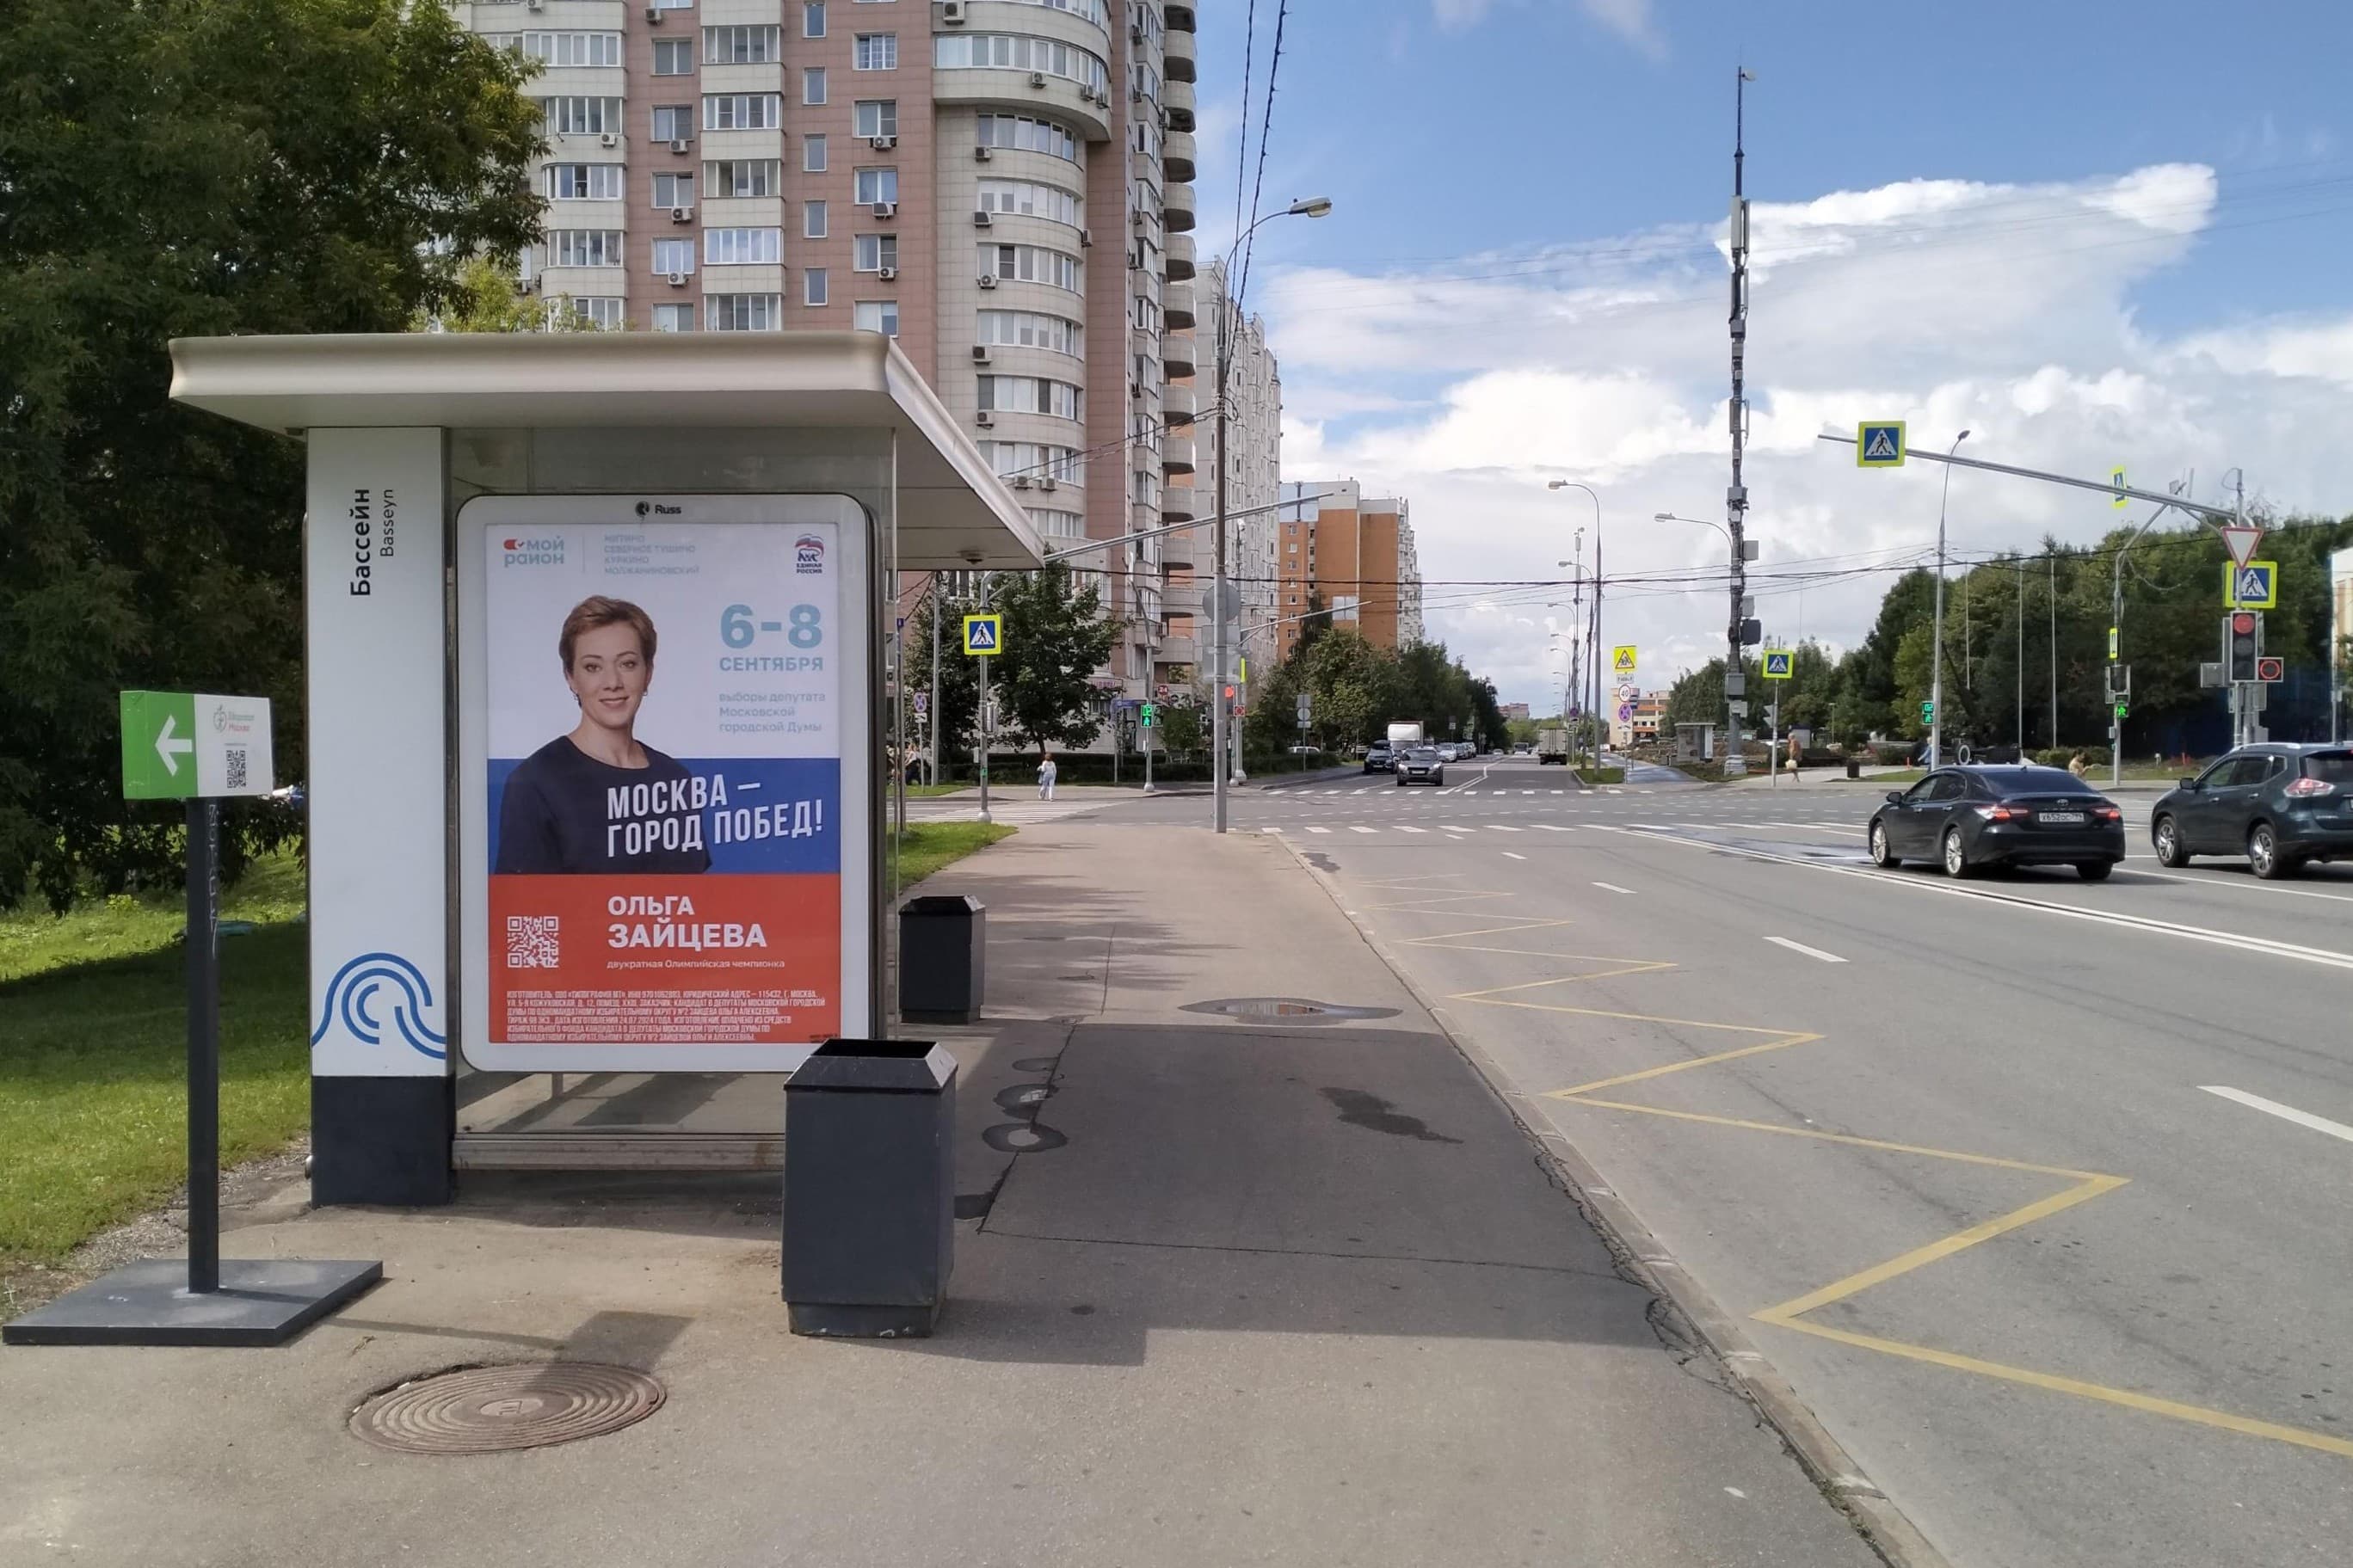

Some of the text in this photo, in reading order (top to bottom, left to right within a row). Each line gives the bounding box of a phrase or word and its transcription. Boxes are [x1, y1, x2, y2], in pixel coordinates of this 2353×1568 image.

[655, 504, 682, 515] Russ
[379, 489, 397, 557] Basseyn
[349, 489, 371, 596] Бассейн
[604, 544, 651, 553] СЕВЕРНОЕ
[719, 656, 823, 672] СЕНТЯБРЯ
[719, 692, 826, 704] выборы депутата
[719, 705, 796, 716] Московской
[719, 721, 822, 735] городской Думы
[607, 774, 728, 820] МОСКВА
[607, 798, 822, 858] ГОРОД ПОБЕД!
[607, 895, 695, 916] ОЛЬГА
[607, 916, 767, 952] ЗАЙЦЕВА
[607, 958, 785, 969] двукратная Олимпийская чемпионка
